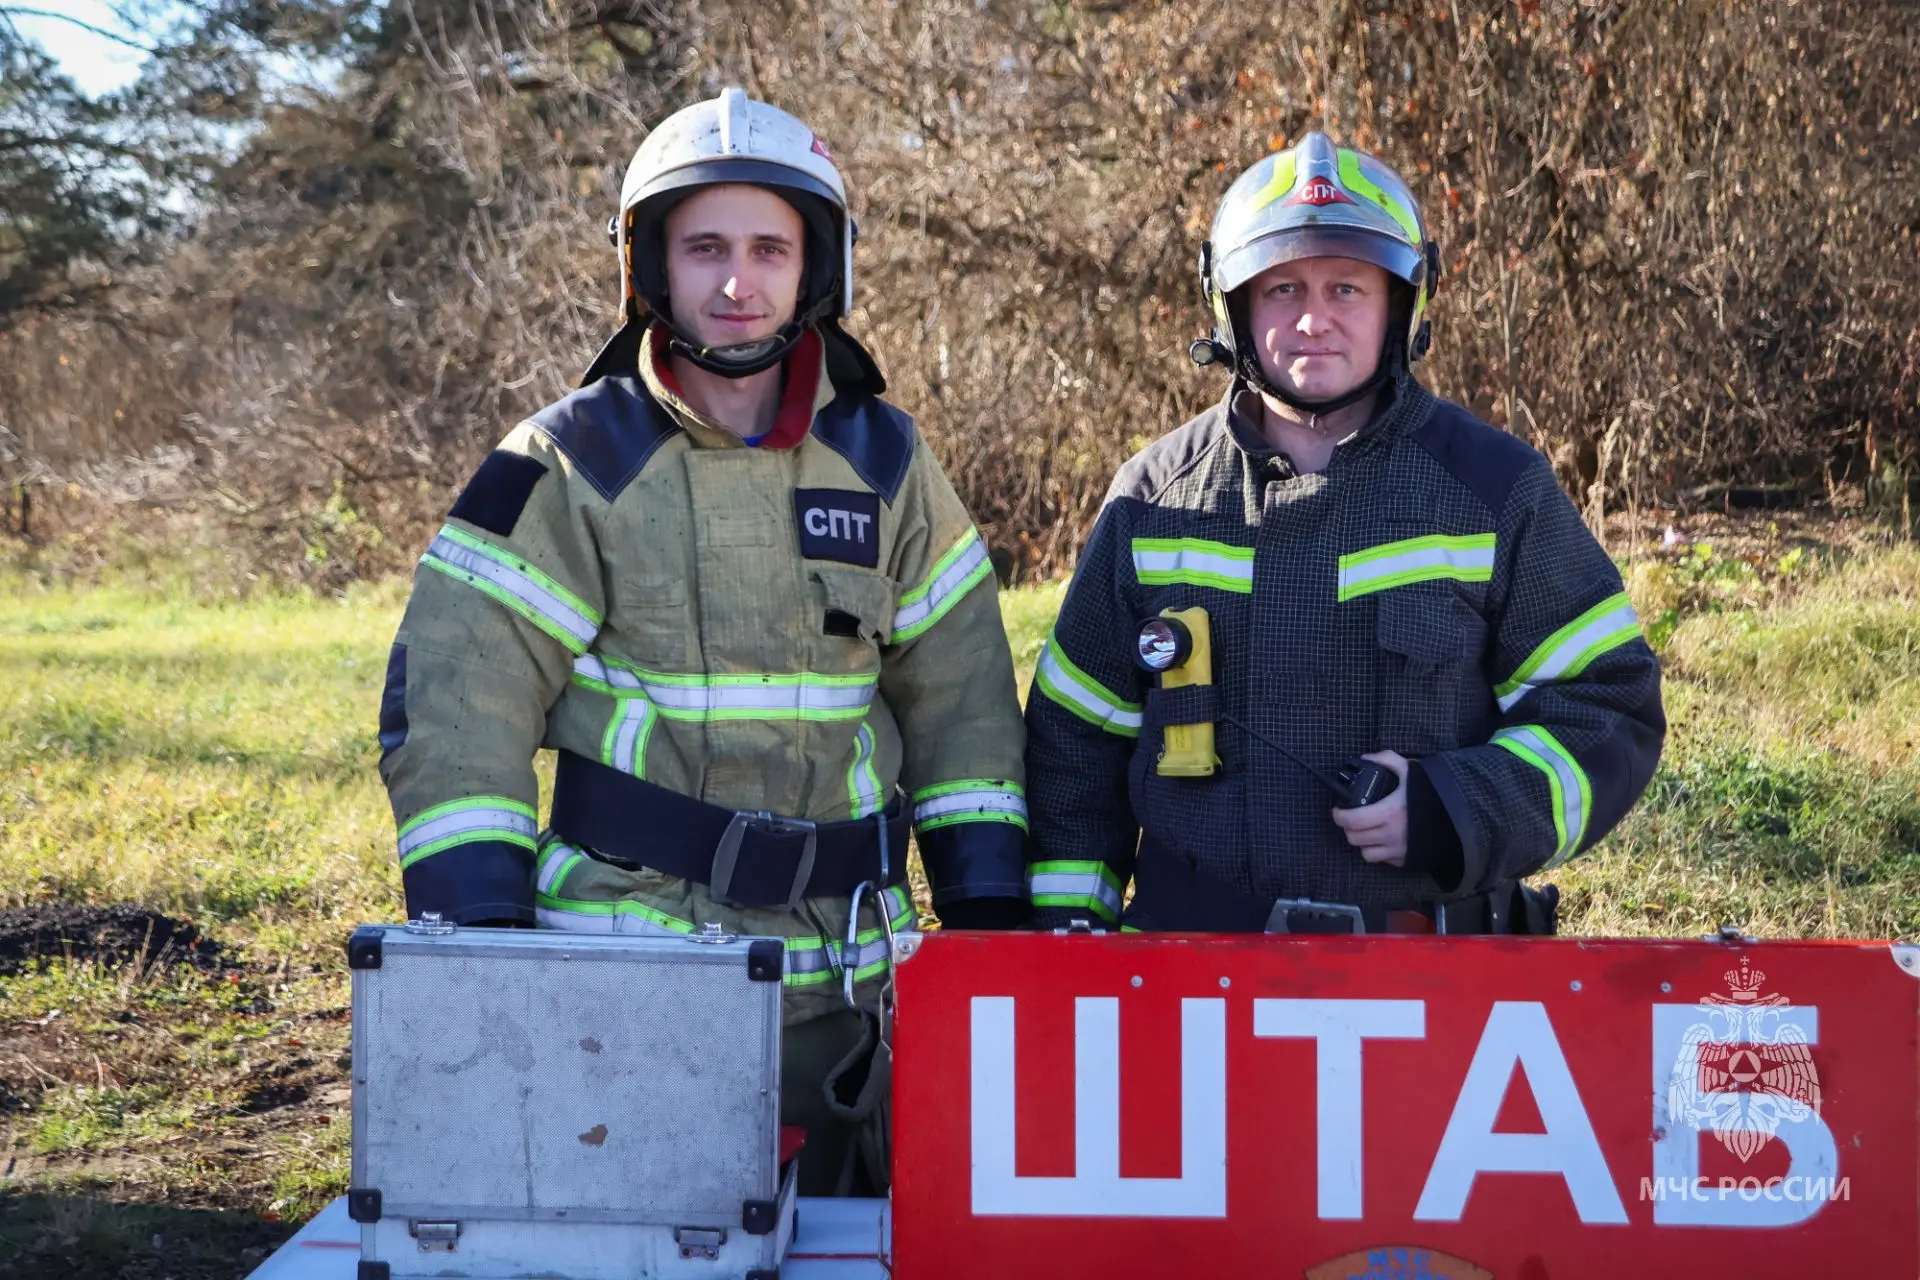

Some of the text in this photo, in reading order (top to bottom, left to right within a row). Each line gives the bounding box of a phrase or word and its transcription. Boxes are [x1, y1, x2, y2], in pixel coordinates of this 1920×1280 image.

[1301, 184, 1337, 200] СПТ
[804, 507, 871, 543] СПТ
[970, 996, 1840, 1228] ШТАБ
[1367, 1248, 1431, 1267] МЧС
